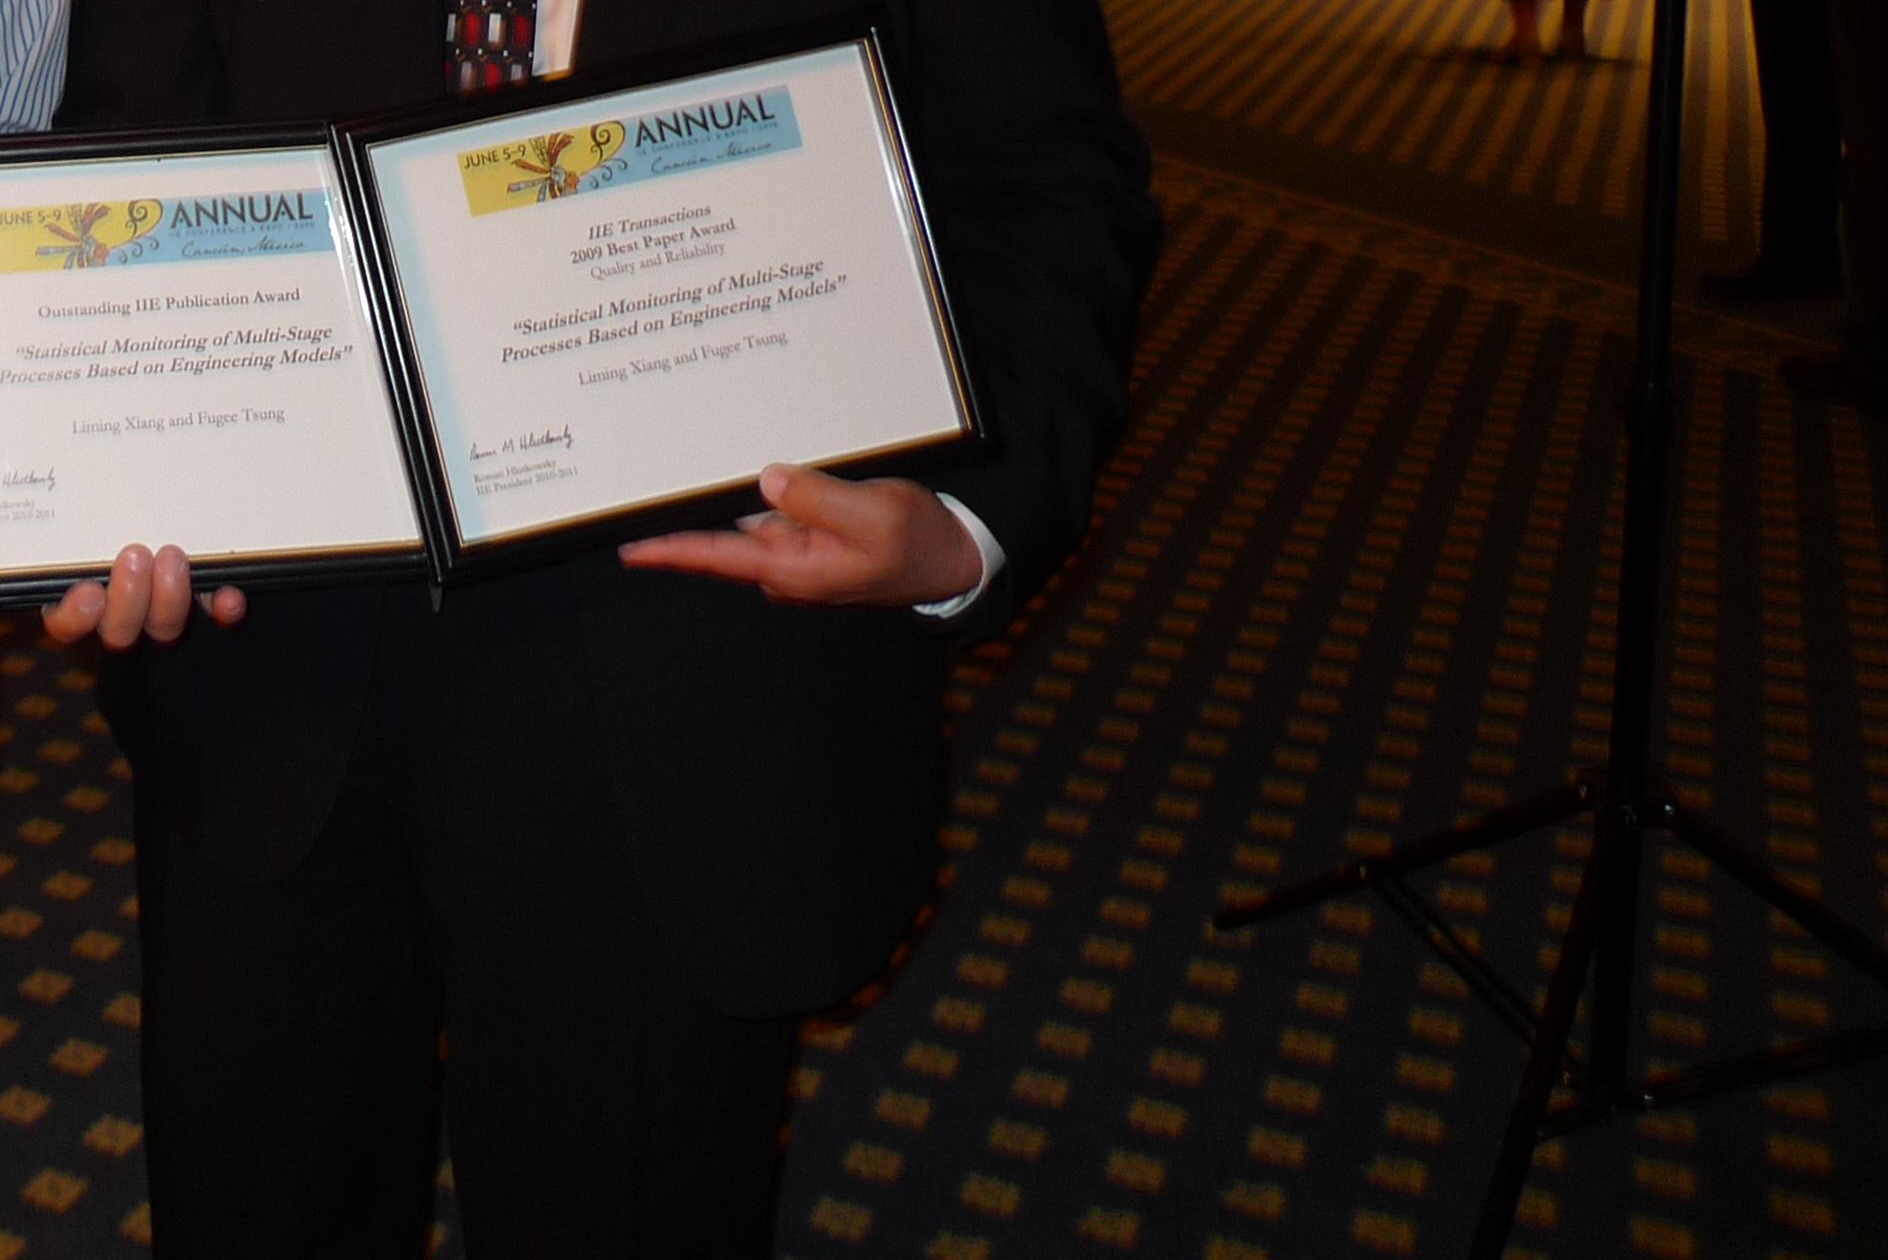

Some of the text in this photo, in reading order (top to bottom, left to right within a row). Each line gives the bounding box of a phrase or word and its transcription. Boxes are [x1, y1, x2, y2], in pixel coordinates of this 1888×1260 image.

[635, 94, 775, 148] ANNUAL
[464, 150, 500, 169] JUNE
[170, 193, 313, 229] ANNUAL
[588, 205, 712, 240] IIE Transactions
[570, 218, 737, 264] 2009 Best Paper Award
[590, 242, 726, 281] Quality and Reliability
[38, 288, 301, 319] Outstanding IIE Publication Award
[513, 260, 824, 335] “Statistical Monitoring of Multi-Stage
[502, 274, 847, 363] Processes Based on Engineering Models”
[16, 326, 333, 360] “Statistical Monitoring of Multi-Stage
[579, 331, 788, 385] Liming Xiang and Fugee Tsung
[86, 361, 139, 379] Based
[143, 363, 164, 374] on
[170, 352, 276, 375] Engineering
[72, 407, 285, 435] Liming Xiang and Fugee Tsung
